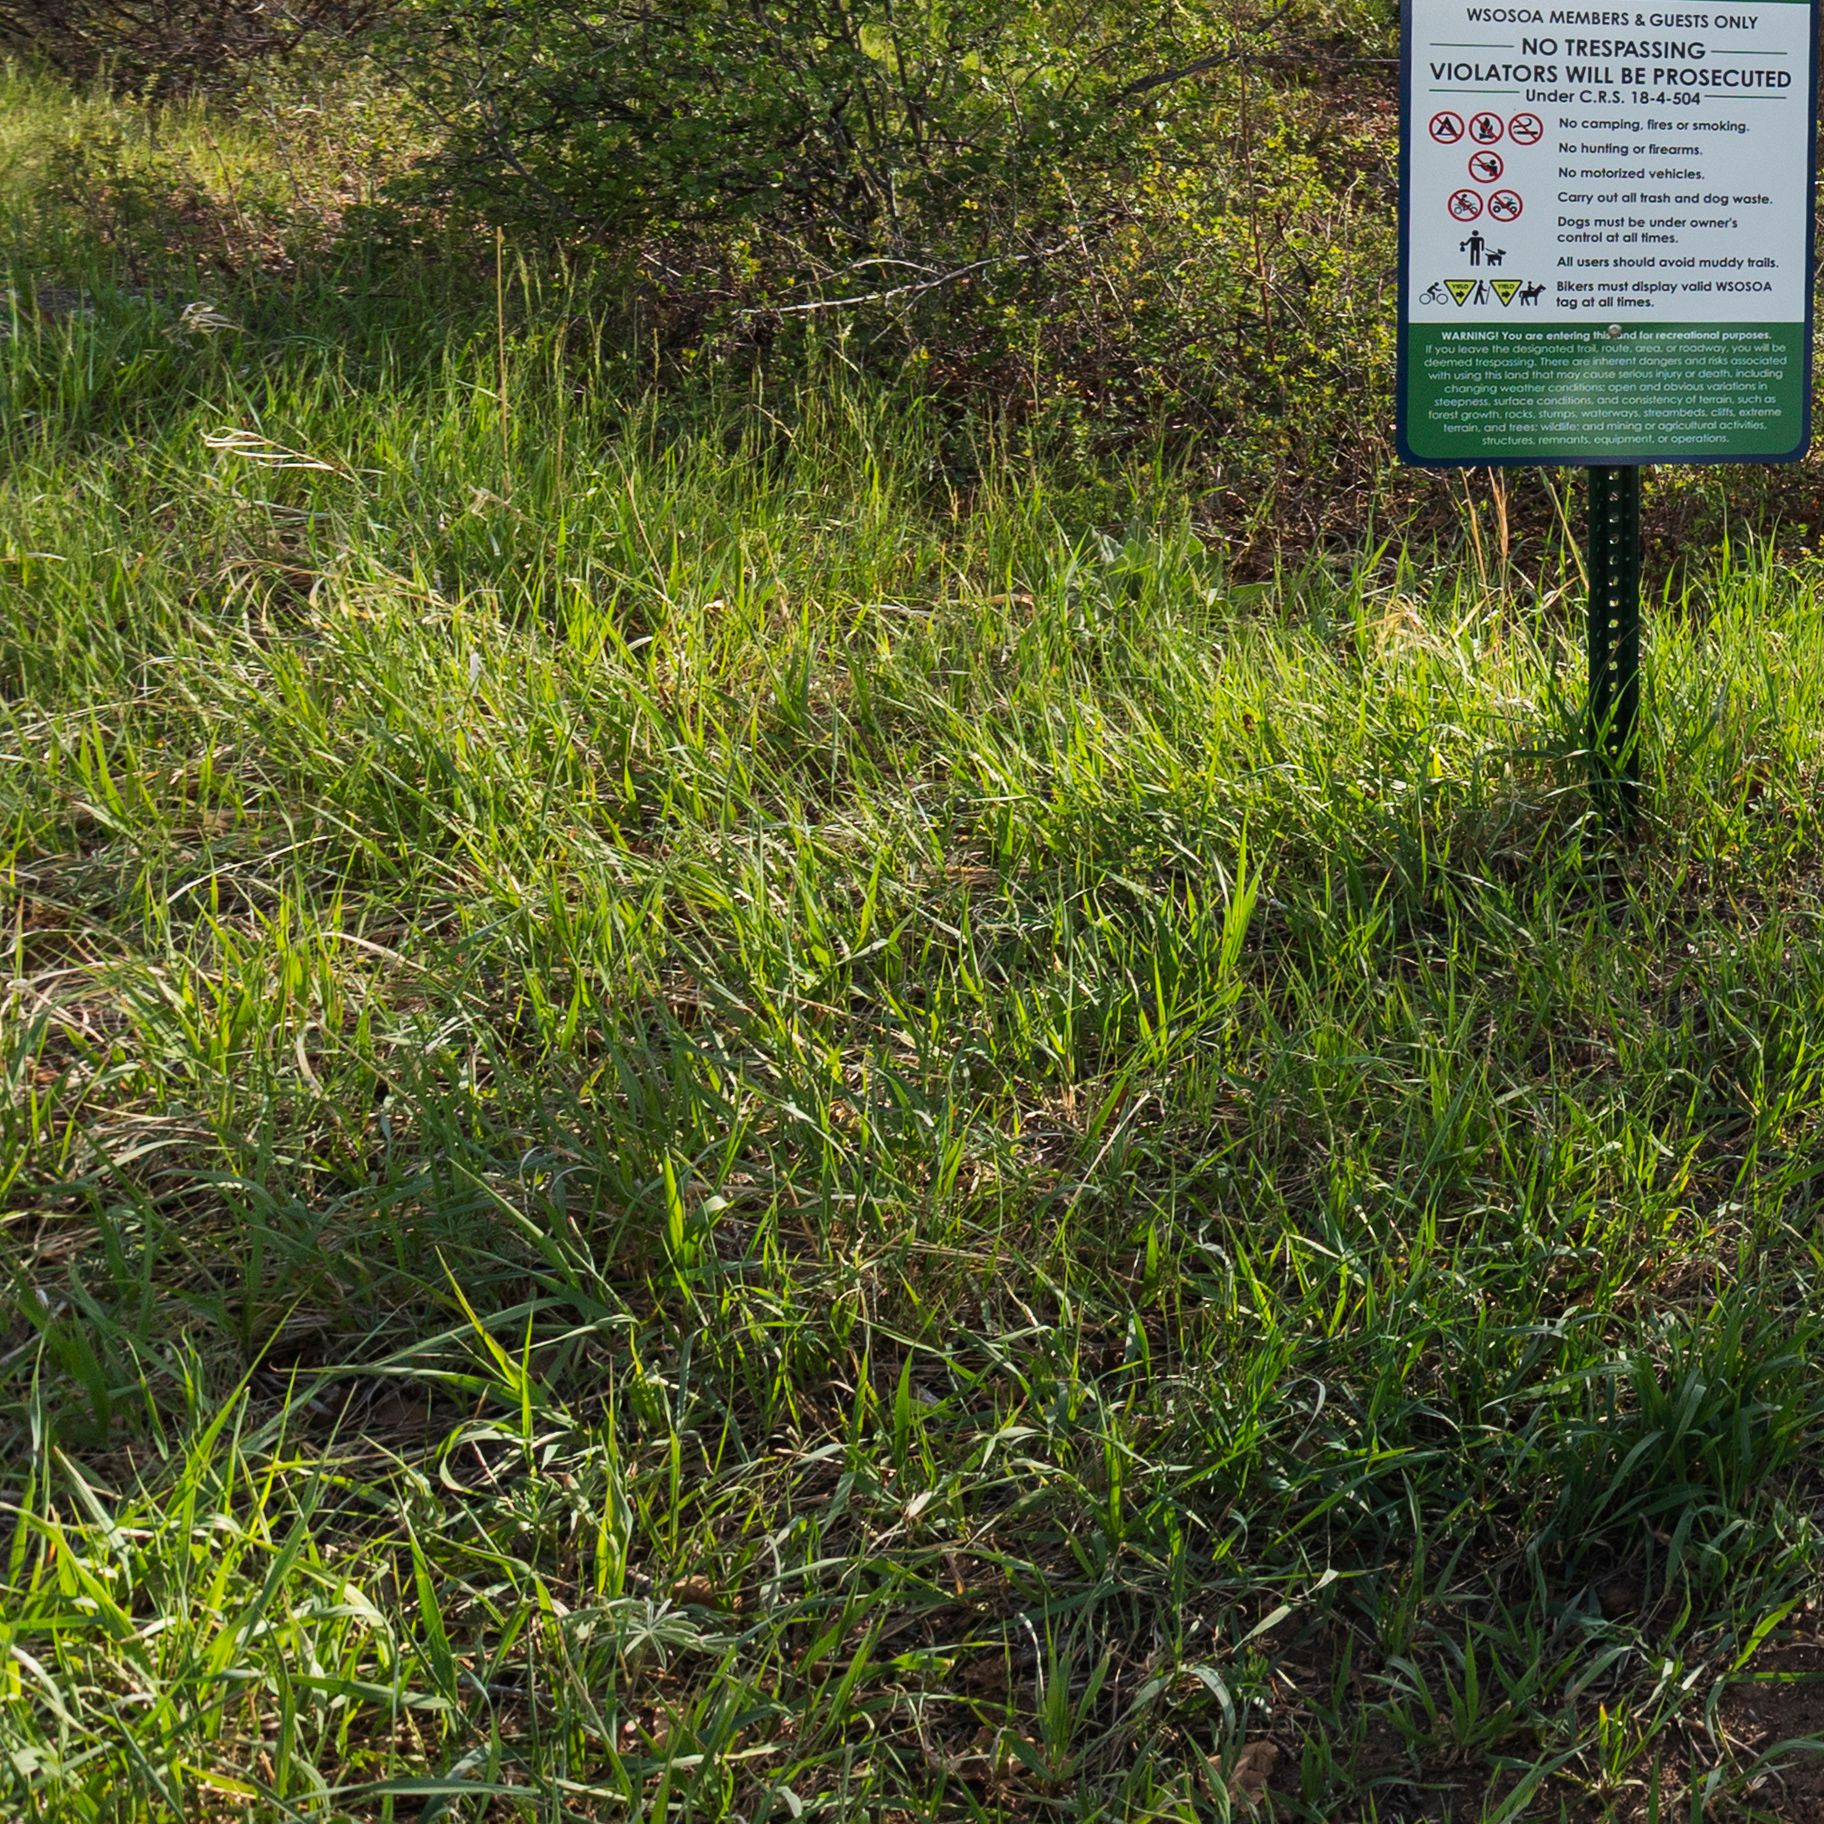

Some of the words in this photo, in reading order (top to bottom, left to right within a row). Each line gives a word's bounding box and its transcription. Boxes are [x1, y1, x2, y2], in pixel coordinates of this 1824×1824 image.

[1467, 8, 1544, 24] WSOSOA
[1550, 10, 1629, 26] MEMBERS
[1635, 14, 1645, 26] &
[1650, 13, 1709, 29] GUESTS
[1714, 15, 1758, 29] ONLY
[1521, 38, 1558, 57] NO
[1564, 39, 1706, 59] TRESPASSING
[1430, 62, 1558, 83] VIOLATORS
[1565, 65, 1617, 84] WILL
[1623, 67, 1645, 84] BE
[1653, 68, 1792, 88] PROSECUTED
[1526, 89, 1575, 104] Under
[1579, 90, 1624, 104] C.R.S.
[1631, 90, 1701, 105] 18-4-504
[1559, 118, 1577, 128] No
[1581, 119, 1643, 132] camping,
[1647, 119, 1672, 130] fires
[1677, 122, 1689, 130] or
[1692, 121, 1750, 134] smoking.
[1559, 143, 1577, 153] No
[1581, 143, 1629, 156] hunting
[1633, 145, 1645, 154] or
[1649, 144, 1703, 155] firearms.
[1559, 167, 1577, 178] No
[1581, 168, 1645, 179] motorized
[1649, 169, 1705, 180] vehicles.
[1558, 192, 1593, 205] Carry
[1597, 193, 1618, 202] out
[1622, 192, 1636, 203] all
[1640, 193, 1670, 204] trash
[1675, 193, 1699, 204] and
[1703, 193, 1729, 206] dog
[1733, 194, 1773, 205] waste.
[1557, 217, 1590, 229] Dogs
[1594, 217, 1625, 227] must
[1629, 217, 1645, 227] be
[1650, 217, 1686, 228] under
[1690, 217, 1738, 228] owner's
[1557, 232, 1602, 243] control
[1607, 233, 1619, 243] at
[1623, 232, 1638, 243] all
[1641, 233, 1679, 243] times.
[1557, 257, 1573, 267] All
[1577, 258, 1609, 267] users
[1613, 257, 1655, 267] should
[1659, 257, 1695, 268] avoid
[1699, 258, 1744, 270] muddy
[1748, 258, 1779, 269] trails.
[1557, 281, 1594, 292] Bikers
[1598, 282, 1629, 292] must
[1632, 281, 1677, 294] display
[1681, 282, 1712, 292] valid
[1716, 282, 1772, 292] WSOSOA
[1556, 297, 1578, 309] tag
[1582, 297, 1595, 307] at
[1599, 297, 1613, 307] all
[1617, 297, 1654, 308] times.
[1442, 331, 1499, 341] WARNING!
[1501, 332, 1522, 340] You
[1525, 332, 1543, 340] are
[1546, 331, 1590, 342] entering
[1593, 331, 1611, 340] this
[1613, 331, 1637, 340] and
[1639, 331, 1653, 340] for
[1656, 331, 1720, 340] recreational
[1425, 345, 1432, 353] If
[1435, 347, 1455, 355] you
[1458, 345, 1489, 353] leave
[1492, 345, 1509, 353] the
[1512, 345, 1574, 355] designated
[1731, 345, 1751, 355] you
[1754, 344, 1770, 352] will
[1772, 344, 1786, 352] be
[1424, 358, 1472, 367] deemed
[1540, 357, 1568, 367] There
[1572, 358, 1590, 366] are
[1593, 357, 1636, 366] inherent
[1639, 357, 1682, 368] dangers
[1685, 357, 1706, 366] and
[1708, 356, 1727, 365] risks
[1731, 356, 1787, 365] associated
[1428, 371, 1450, 380] with
[1454, 371, 1482, 382] using
[1485, 371, 1502, 380] this
[1504, 371, 1529, 380] land
[1532, 370, 1553, 379] that
[1556, 371, 1580, 381] may
[1583, 371, 1615, 380] cause
[1619, 370, 1653, 379] serious
[1656, 369, 1681, 380] injury
[1685, 370, 1695, 378] or
[1736, 369, 1783, 380] including
[1444, 384, 1497, 394] changing
[1500, 384, 1546, 393] weather
[1608, 384, 1637, 393] open
[1639, 382, 1661, 391] and
[1664, 382, 1704, 391] obvious
[1706, 382, 1756, 391] variations
[1759, 382, 1768, 390] in
[1494, 397, 1533, 406] surface
[1597, 396, 1618, 404] and
[1622, 395, 1682, 407] consistency
[1685, 395, 1696, 404] of
[1738, 395, 1762, 404] such
[1484, 424, 1506, 432] and
[1582, 423, 1603, 431] and
[1607, 422, 1642, 432] mining
[1658, 421, 1717, 432] agricultural
